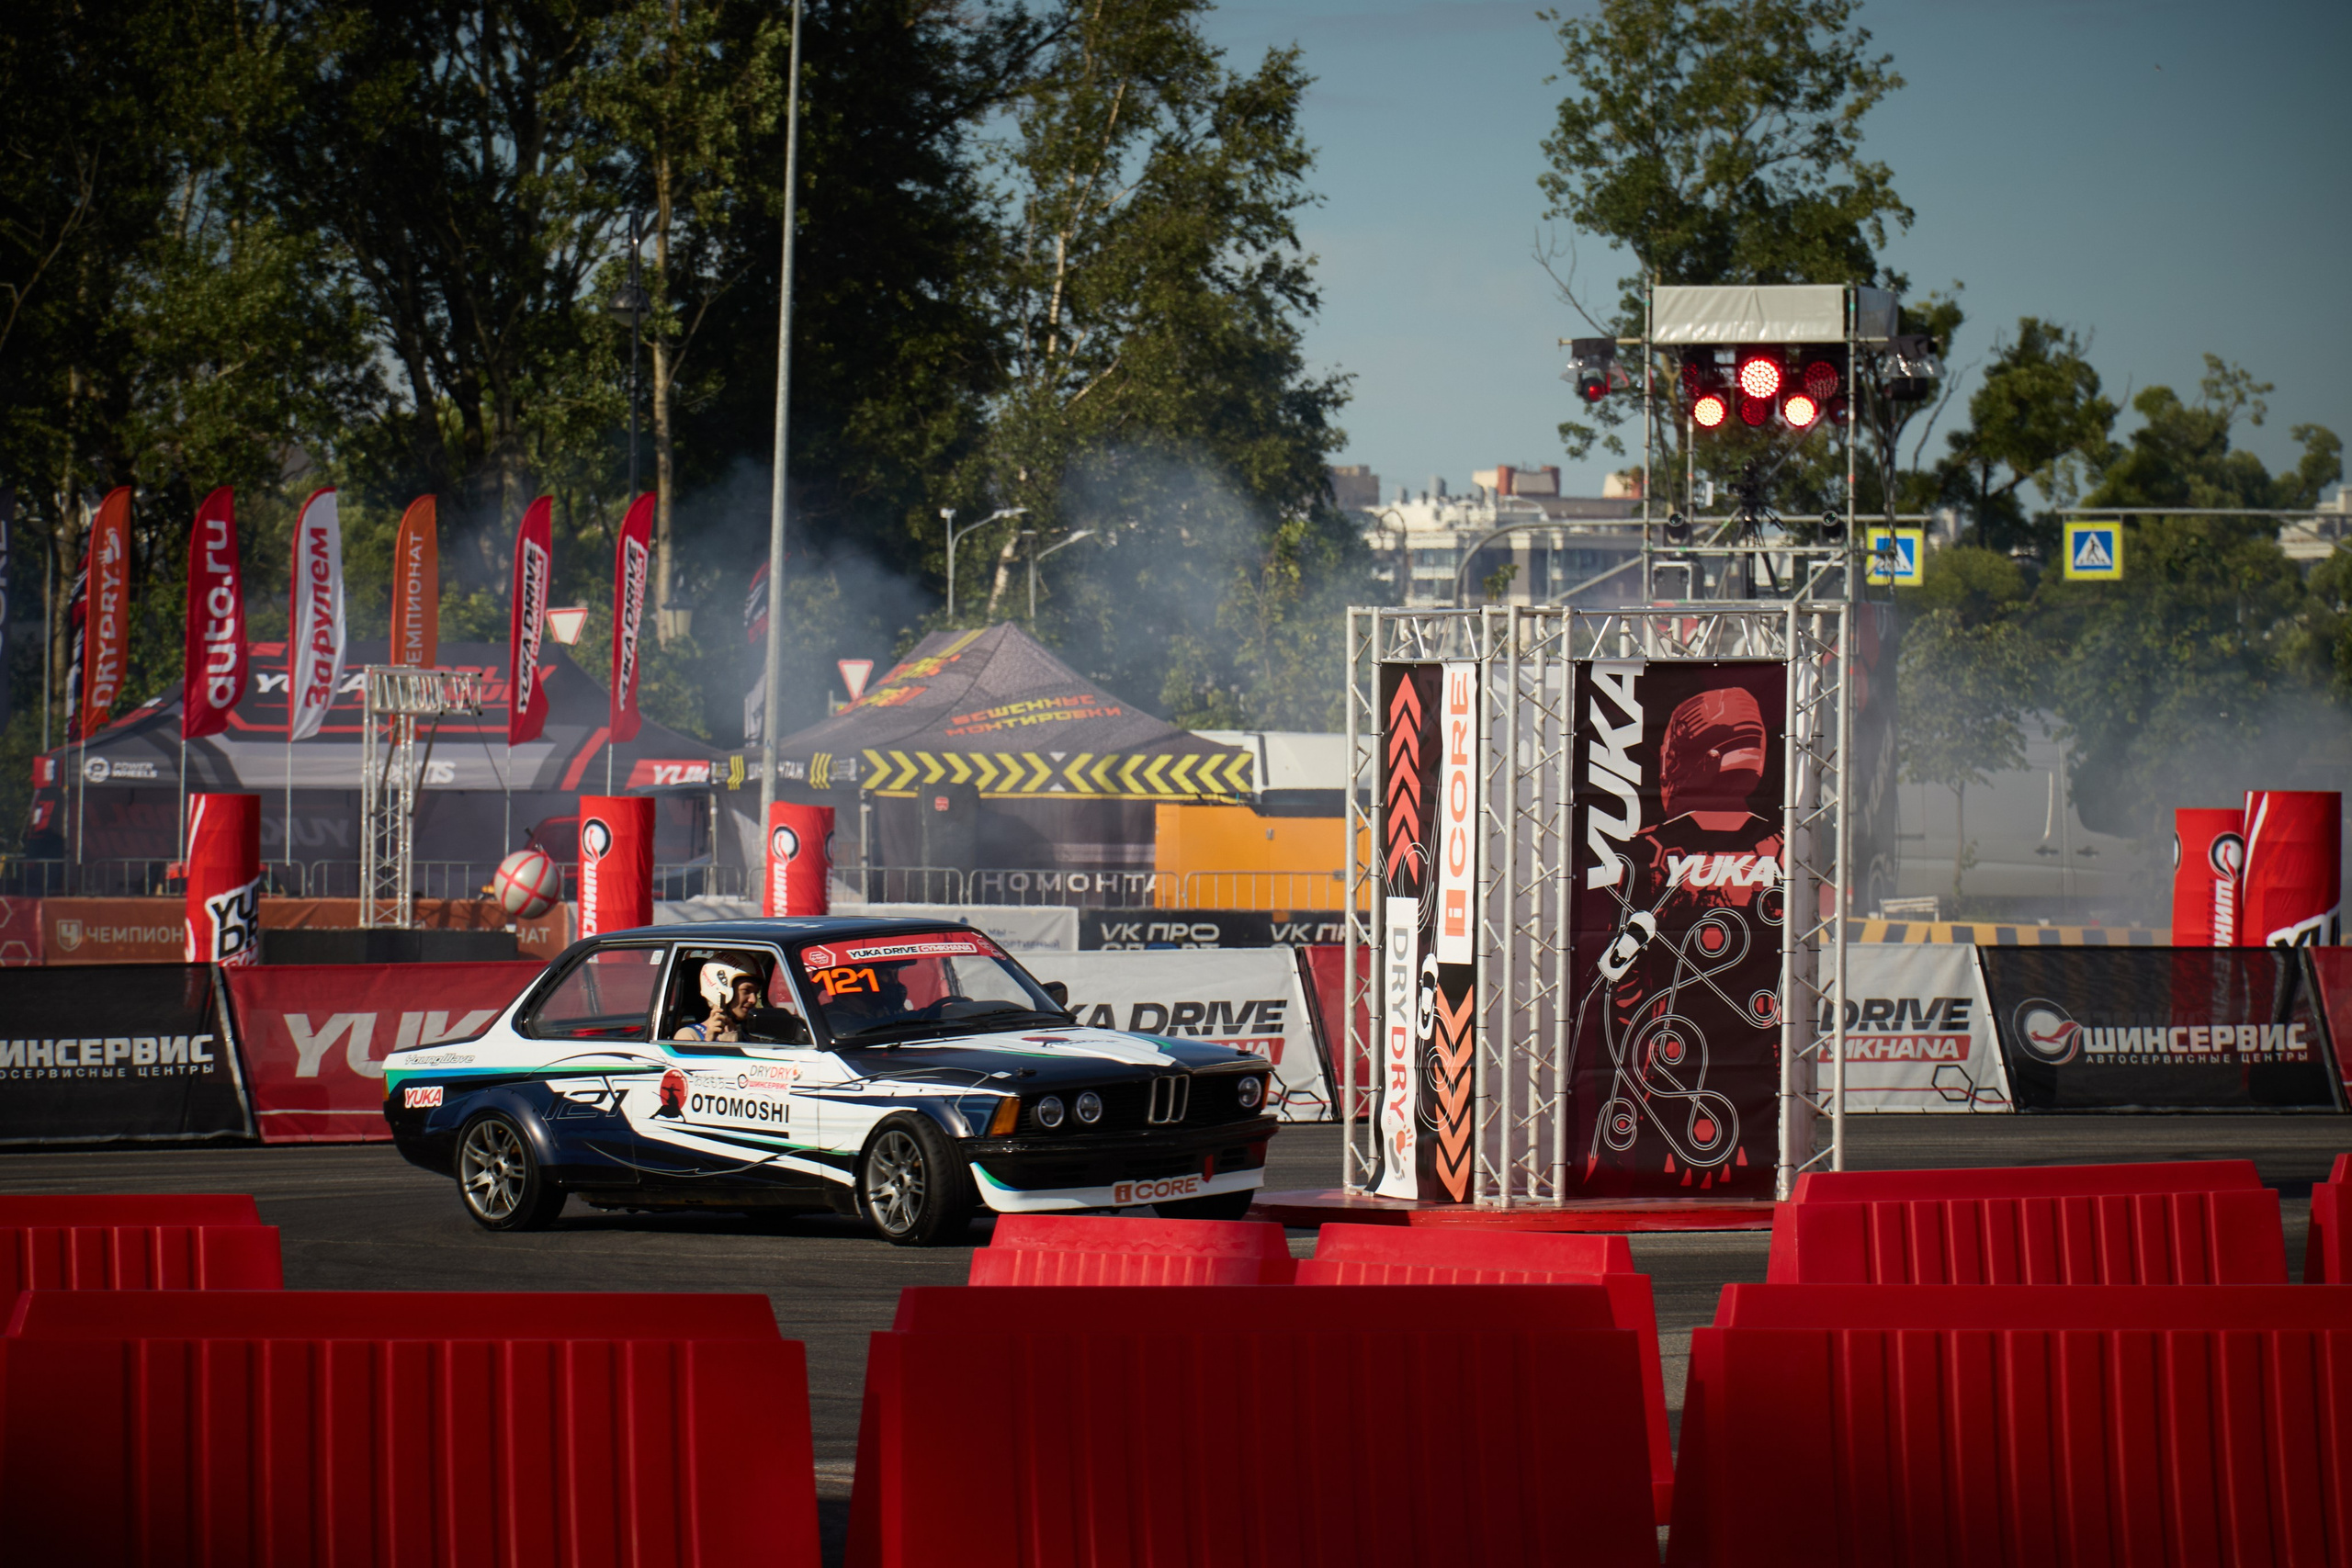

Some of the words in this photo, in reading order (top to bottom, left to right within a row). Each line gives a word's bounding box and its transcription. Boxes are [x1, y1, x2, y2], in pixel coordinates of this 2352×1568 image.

[405, 531, 424, 665] ЕМПИОНАТ
[524, 548, 537, 632] DRIVE
[625, 544, 639, 631] DRIVE
[205, 520, 236, 709] auto.ru
[92, 570, 120, 707] DRYDRY
[1587, 660, 1645, 890] YUKA
[1666, 855, 1779, 887] YUKA
[2213, 879, 2234, 946] ШИН
[85, 926, 184, 944] ЧЕМПИОН
[1101, 923, 1143, 941] VK
[1148, 923, 1220, 942] ПРО
[1270, 923, 1312, 942] VK
[850, 949, 880, 959] YUKA
[883, 946, 918, 955] DRIVE
[920, 944, 972, 953] GYMKHANA
[811, 967, 880, 997] 121
[1128, 1000, 1288, 1036] DRIVE
[1389, 927, 1408, 1121] DRYDRY
[1820, 998, 1973, 1032] DRIVE
[2083, 1023, 2308, 1053] ШИНСЕРВИС
[138, 1065, 214, 1077] ЦЕНТРЫ
[750, 1065, 792, 1079] DRYDRY
[2086, 1054, 2231, 1065] АВТОСЕРВИСНЫЕ
[2242, 1052, 2308, 1064] ЦЕНТРЫ
[405, 1088, 443, 1107] YUKA
[692, 1093, 790, 1123] OTOMOSHI
